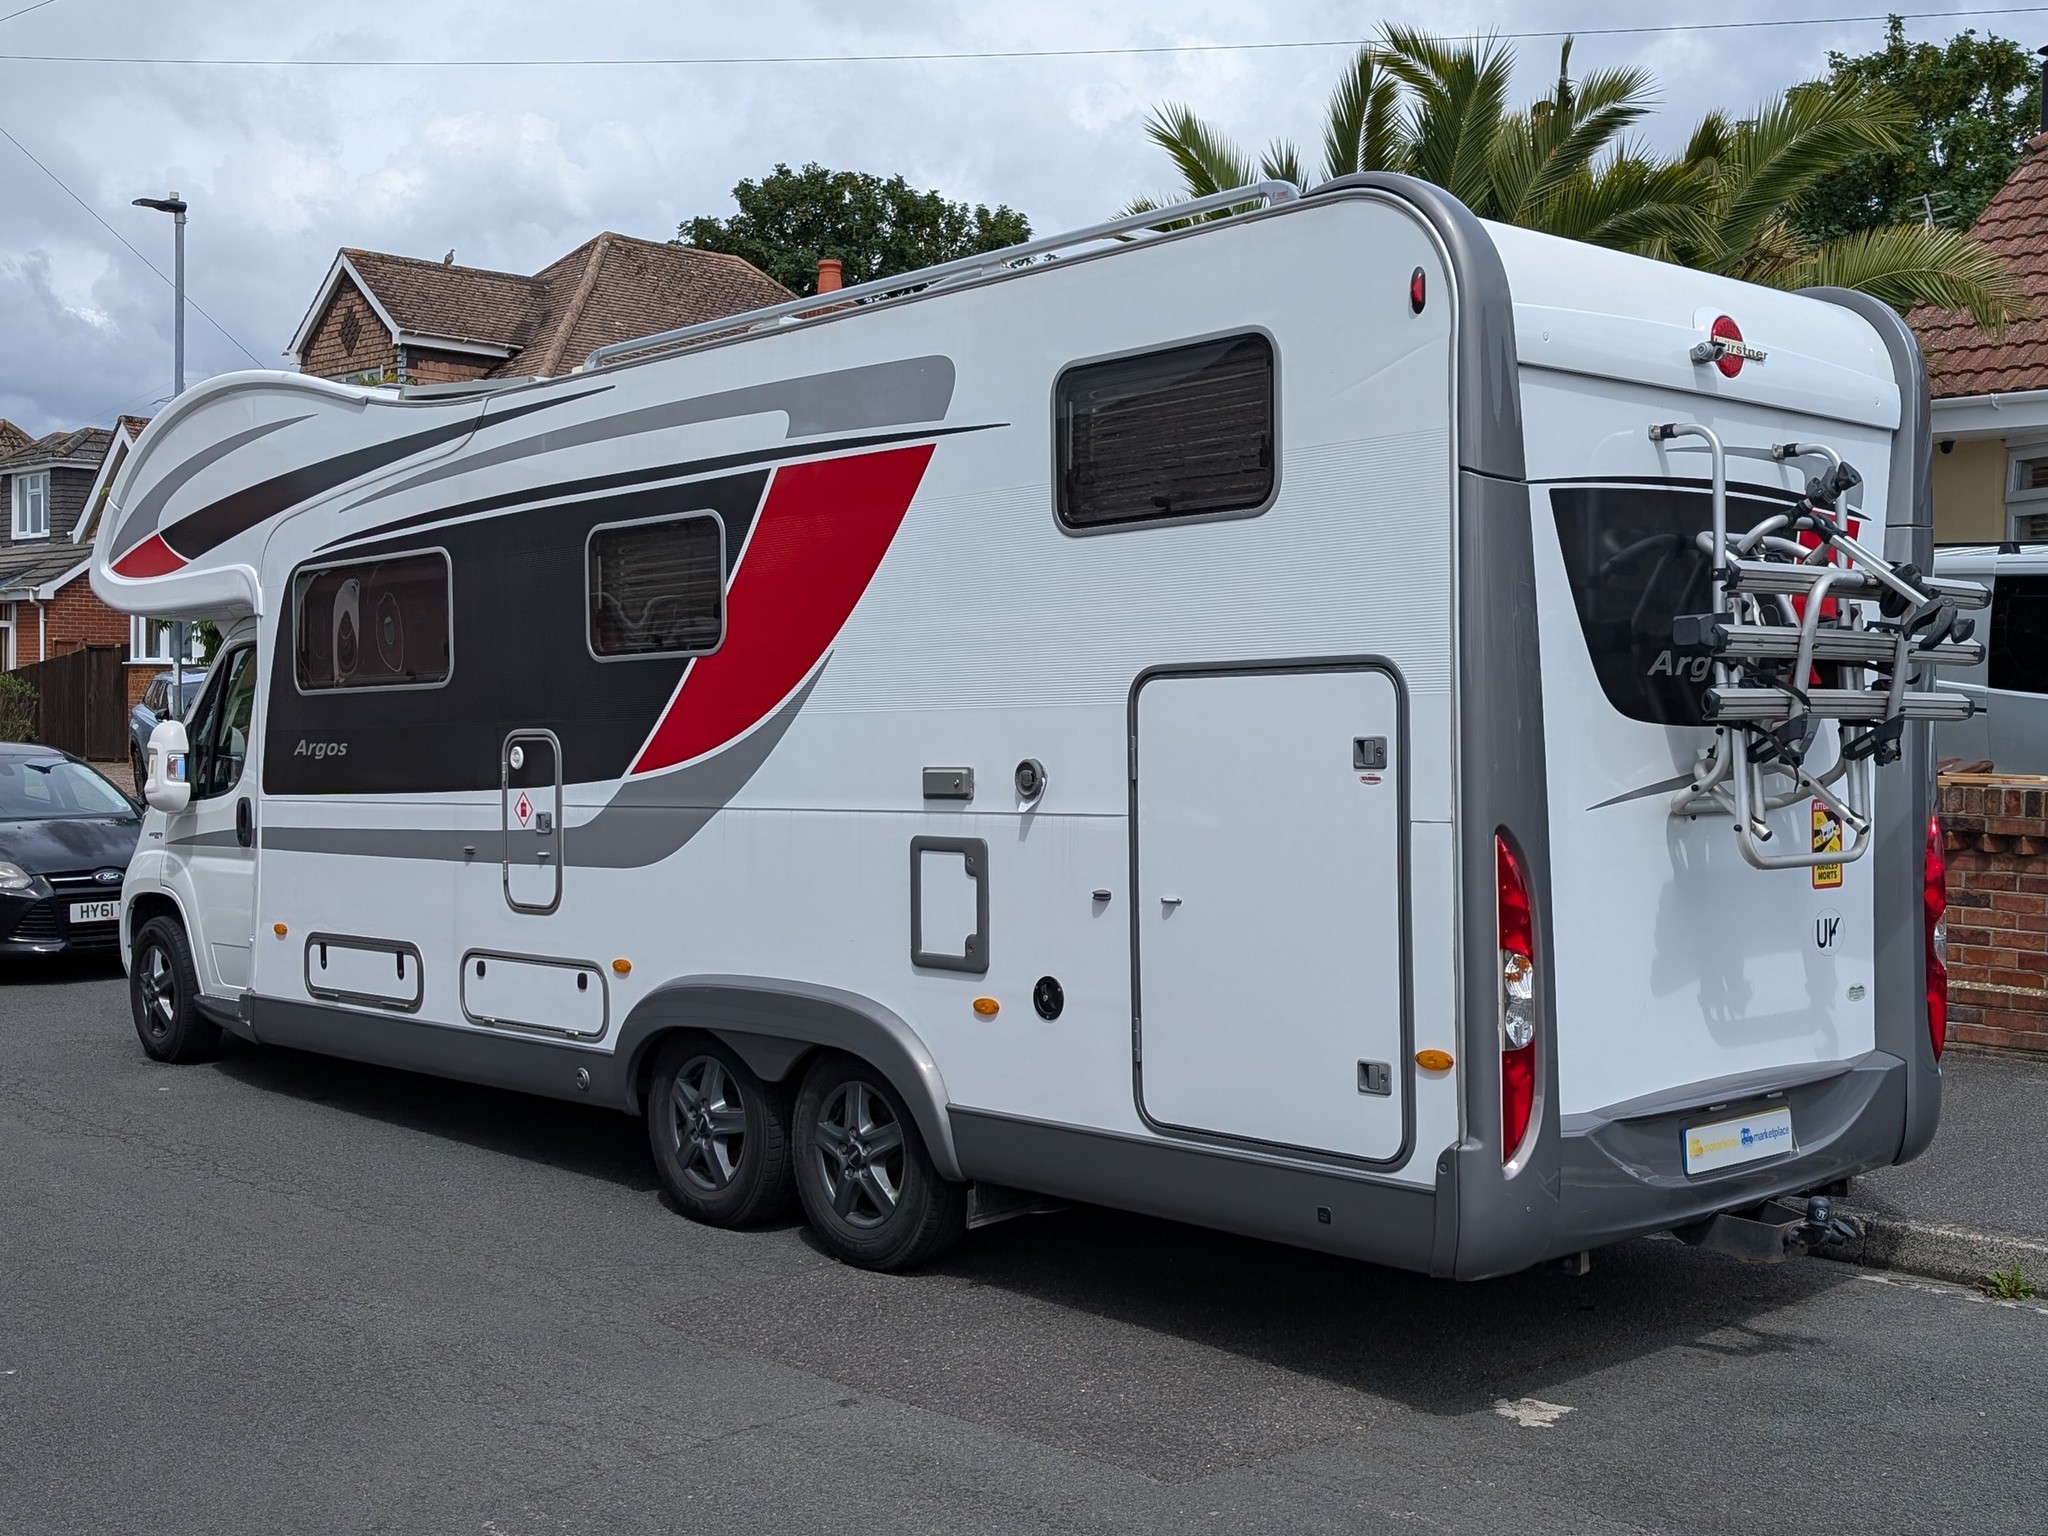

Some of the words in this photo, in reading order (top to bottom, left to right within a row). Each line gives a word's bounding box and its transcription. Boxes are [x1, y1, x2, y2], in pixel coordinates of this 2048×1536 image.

[1647, 650, 1715, 682] Arg
[294, 739, 348, 760] Argos
[1818, 870, 1838, 880] MORTS
[80, 903, 114, 919] HY61
[1816, 917, 1840, 949] UK
[1753, 1126, 1790, 1141] marketplace
